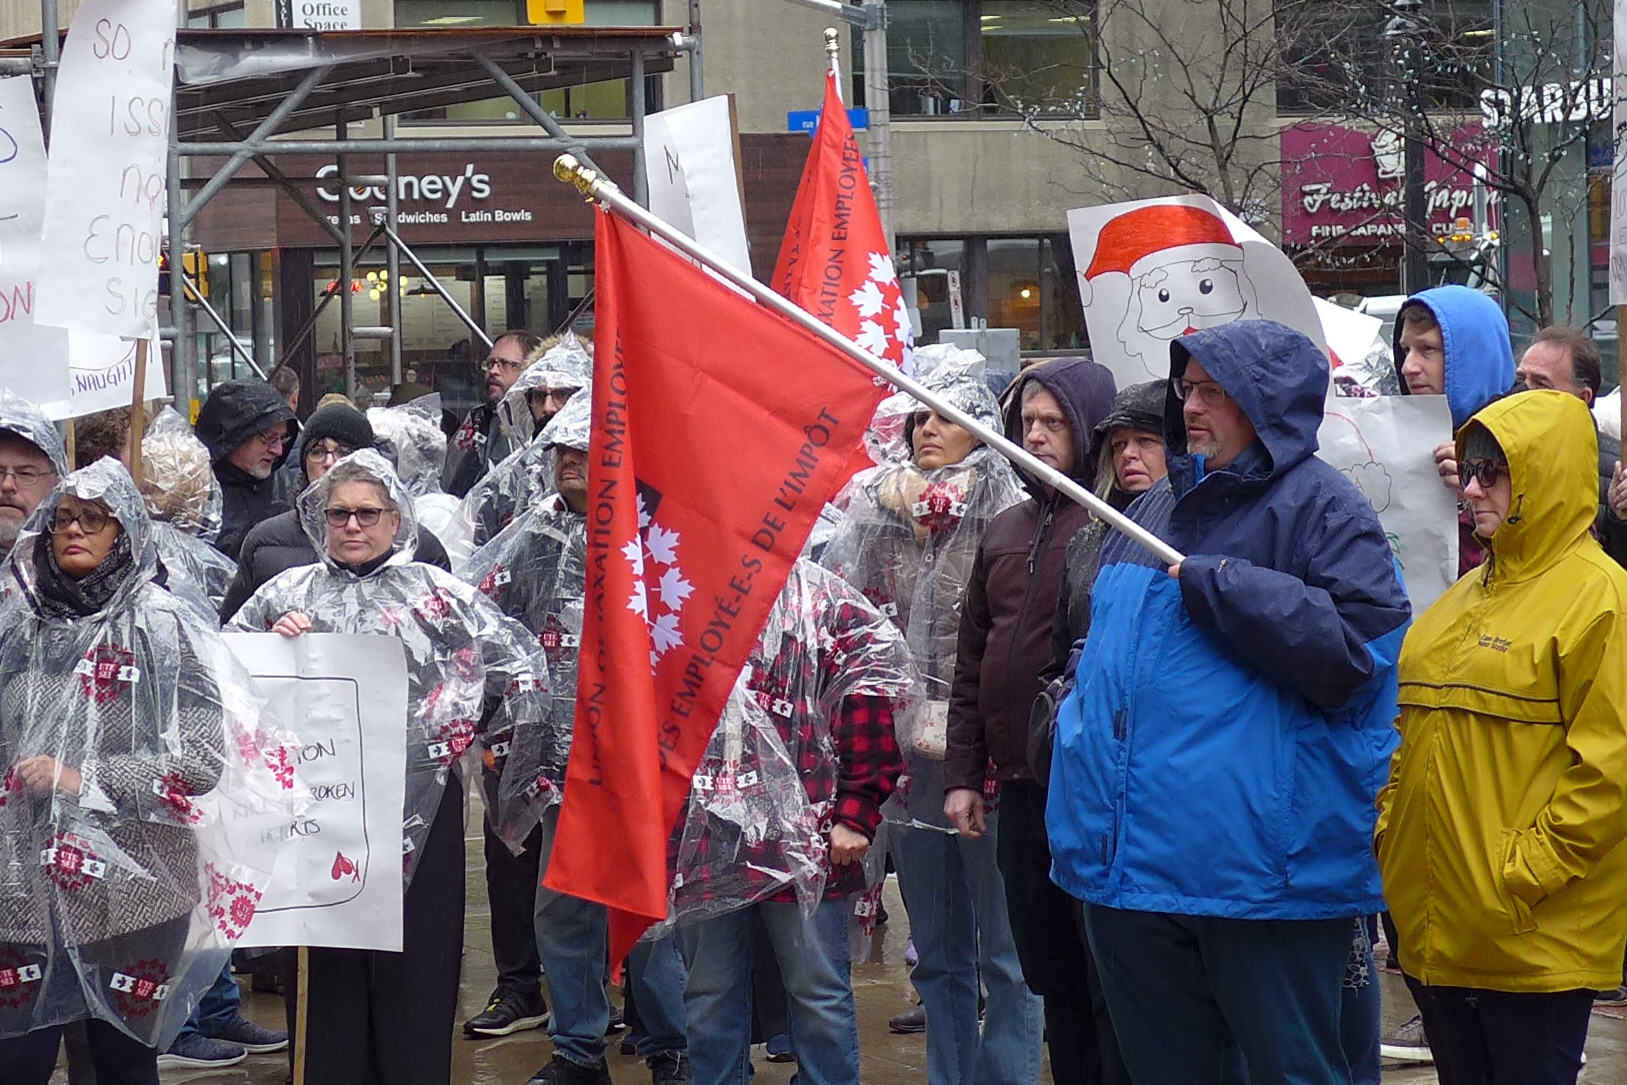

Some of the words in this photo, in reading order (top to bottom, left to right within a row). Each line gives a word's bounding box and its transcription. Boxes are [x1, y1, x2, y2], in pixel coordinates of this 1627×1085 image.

[301, 2, 348, 16] Office
[303, 18, 348, 31] Space
[93, 18, 131, 60] SO
[1480, 78, 1612, 128] STARBU
[374, 211, 448, 224] Sdwiches
[461, 210, 491, 223] Latin
[494, 209, 532, 222] Bowls
[817, 248, 846, 328] XATION
[75, 357, 135, 393] NAUGHT
[670, 554, 763, 719] EMPLOYÉ-E-S
[751, 511, 786, 553] DE
[774, 406, 839, 512] L'IMPÔT
[310, 781, 355, 802] ROKEN
